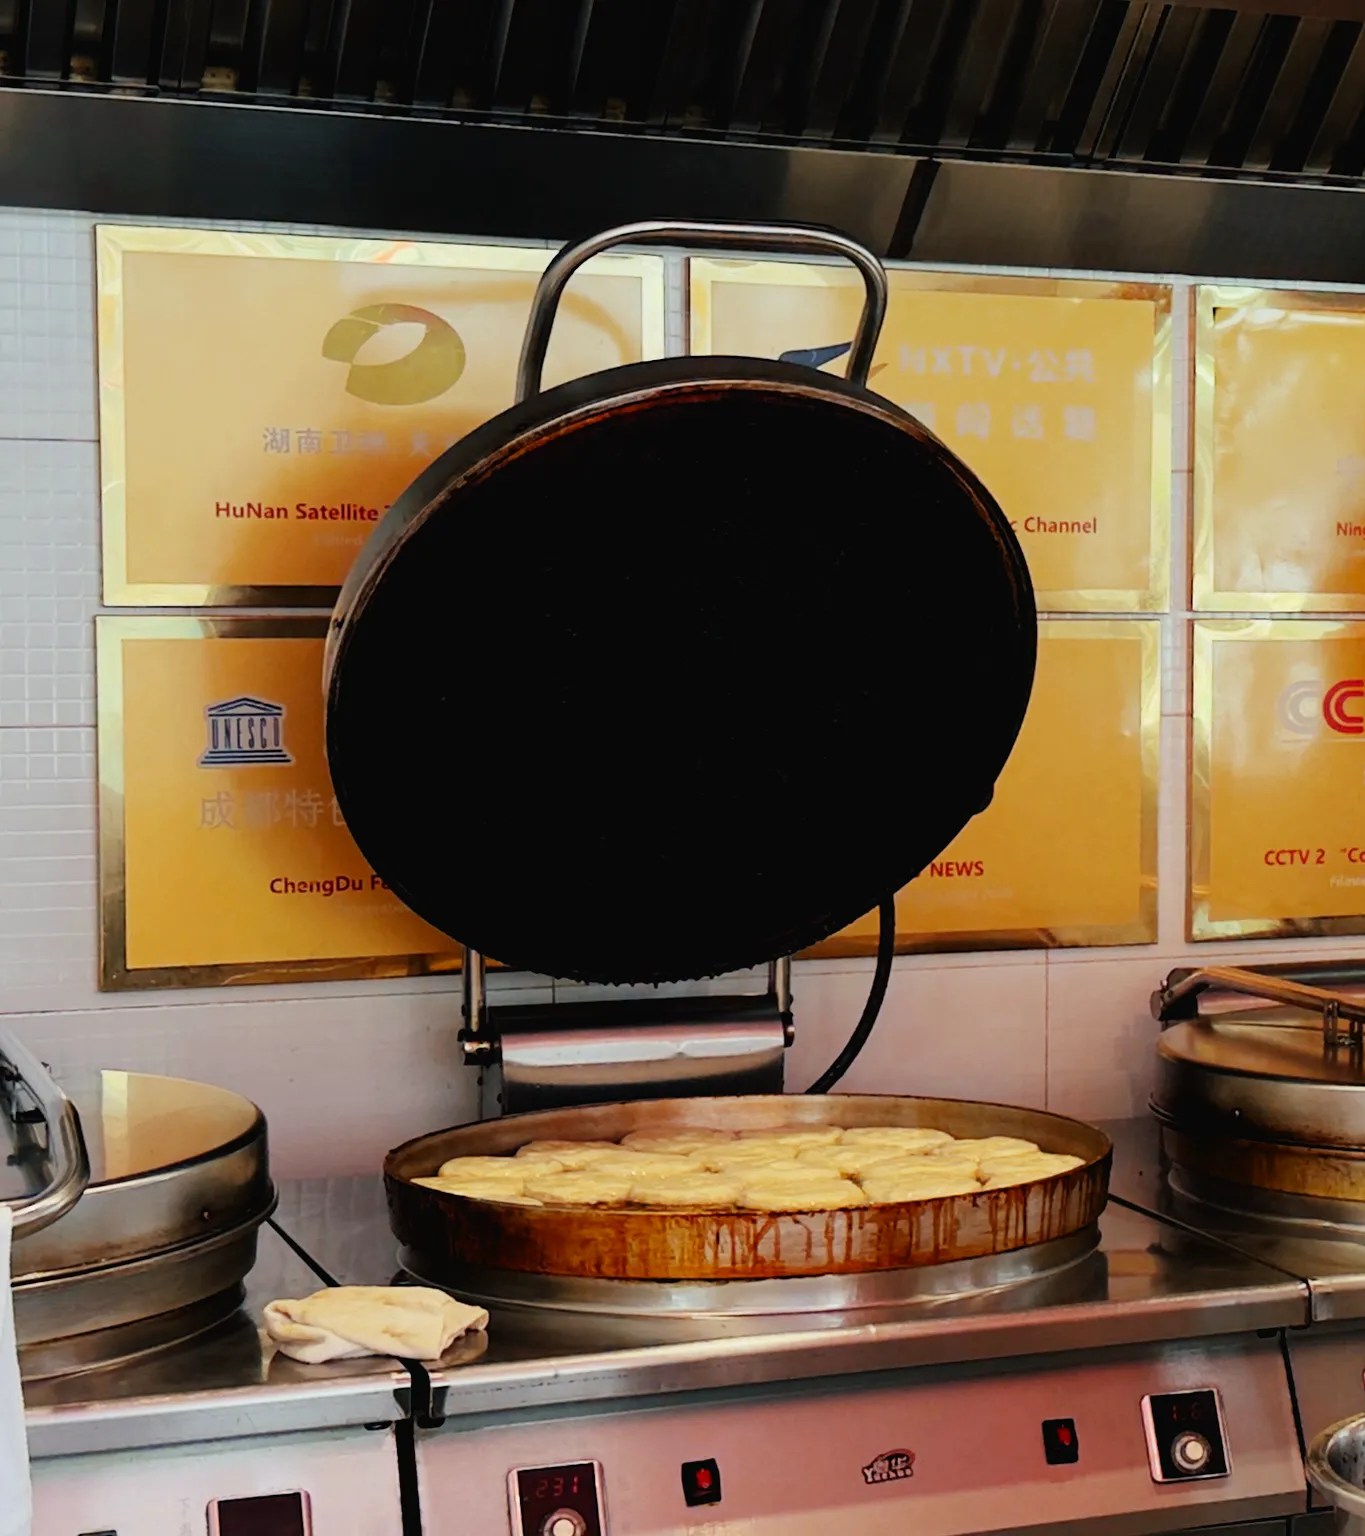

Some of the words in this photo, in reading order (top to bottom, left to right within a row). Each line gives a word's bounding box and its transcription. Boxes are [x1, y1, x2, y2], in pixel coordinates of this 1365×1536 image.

[215, 502, 288, 519] HuNan
[296, 503, 378, 521] Satellite
[1024, 516, 1097, 533] Channel
[212, 717, 279, 749] UNESCO
[1264, 849, 1310, 866] CCTV
[1316, 848, 1325, 865] 2
[930, 861, 984, 877] NEWS
[270, 875, 363, 896] ChengDu
[536, 1475, 579, 1498] 231
